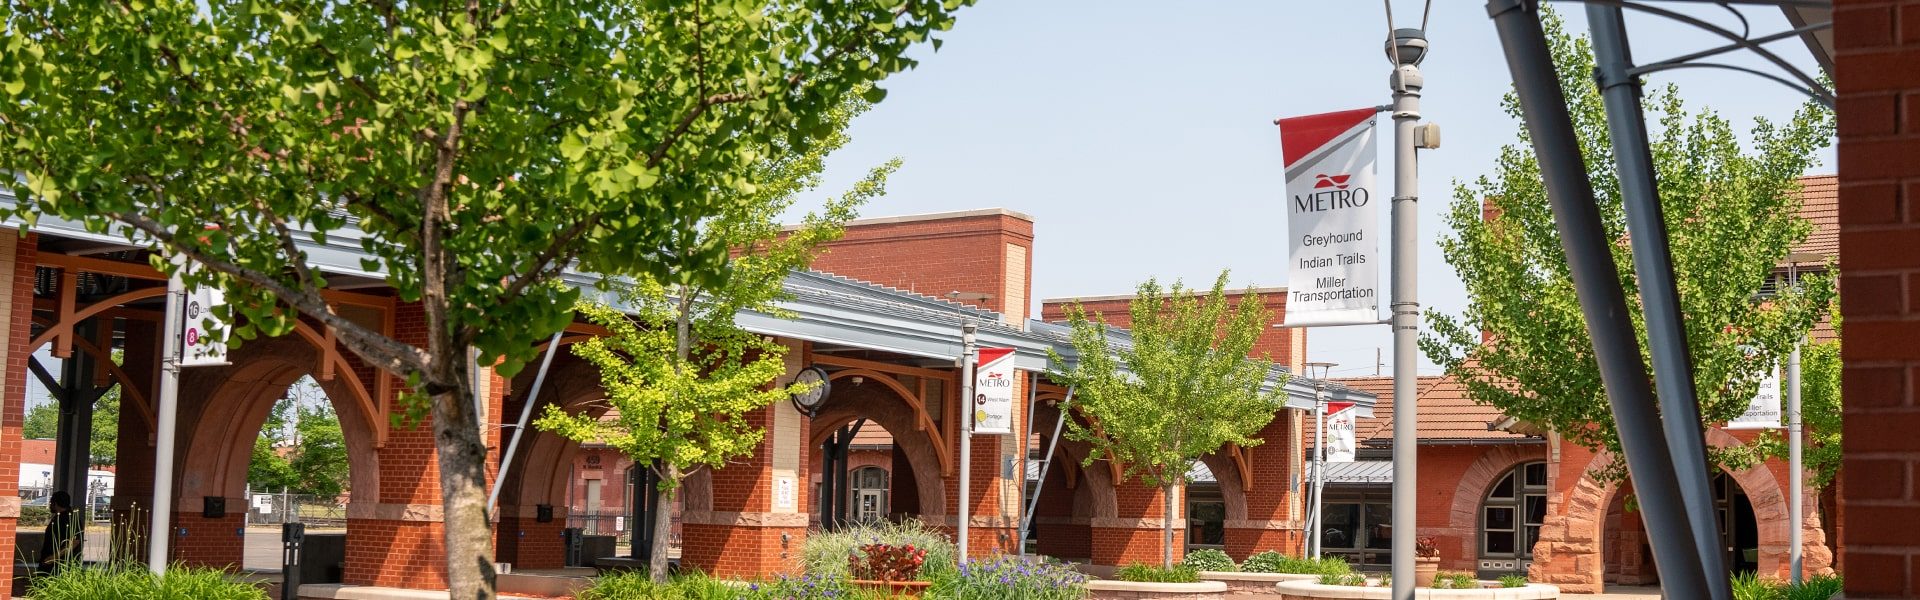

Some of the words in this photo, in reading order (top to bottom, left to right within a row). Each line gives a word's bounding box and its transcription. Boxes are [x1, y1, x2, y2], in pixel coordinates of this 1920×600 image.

[1295, 188, 1369, 214] METRO
[1302, 229, 1363, 247] Greyhound
[1300, 256, 1333, 269] Indian
[1336, 252, 1366, 266] Trails
[1316, 276, 1346, 289] Miller
[1293, 286, 1374, 303] Transportation
[189, 305, 198, 314] 16
[979, 379, 1010, 388] METRO
[978, 395, 986, 403] 14
[1328, 423, 1354, 431] METRO
